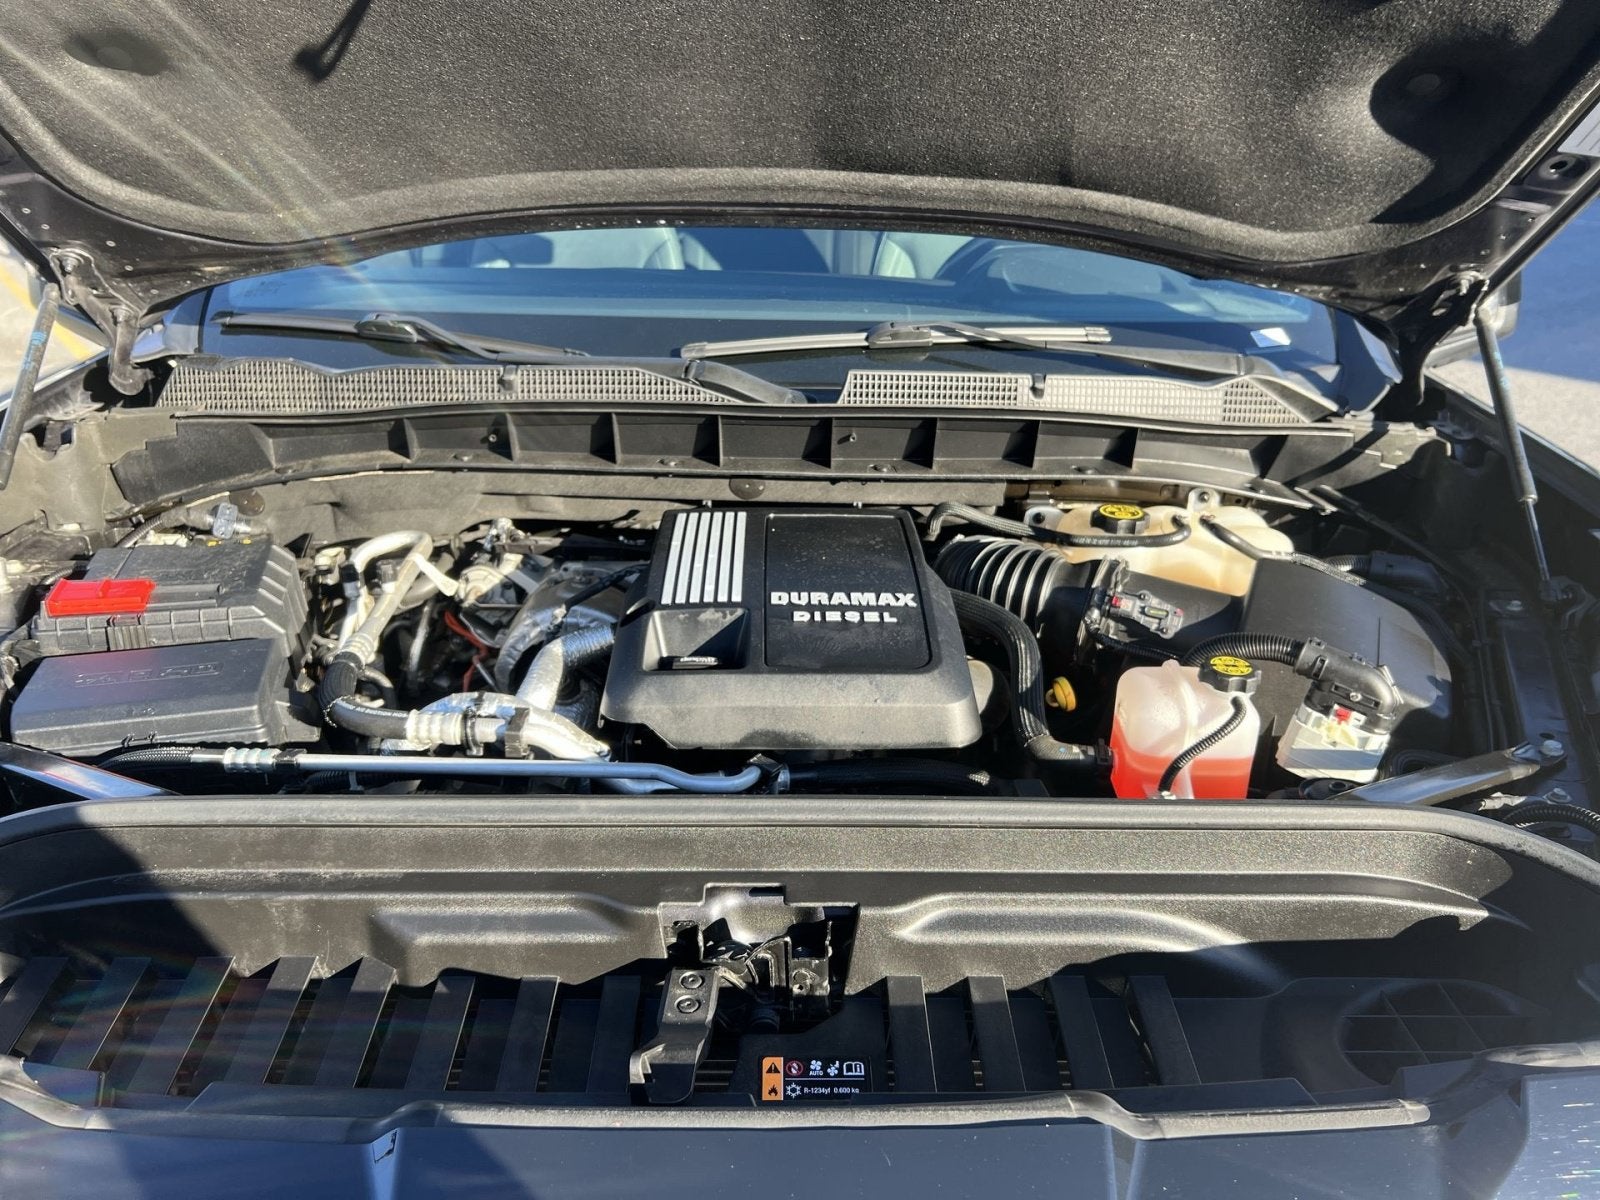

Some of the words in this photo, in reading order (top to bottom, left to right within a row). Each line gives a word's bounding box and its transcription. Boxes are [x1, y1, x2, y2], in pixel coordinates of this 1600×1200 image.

[770, 591, 917, 607] DURAMAX
[793, 611, 898, 623] DIESEL
[803, 1087, 831, 1095] R-1234yf
